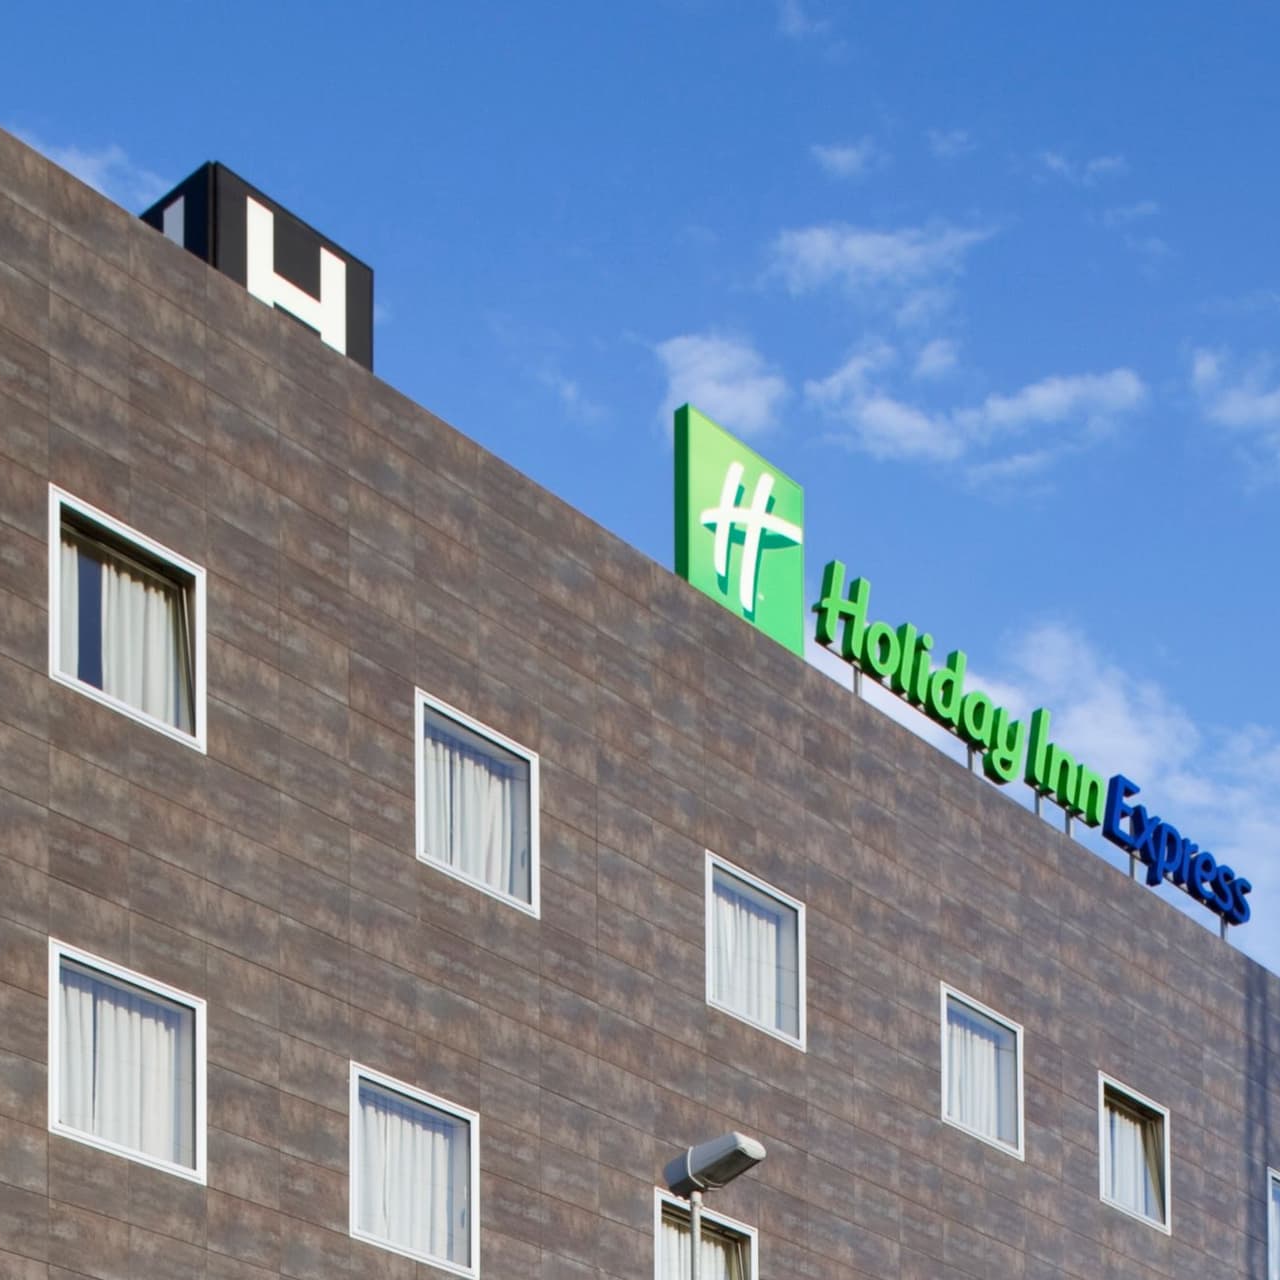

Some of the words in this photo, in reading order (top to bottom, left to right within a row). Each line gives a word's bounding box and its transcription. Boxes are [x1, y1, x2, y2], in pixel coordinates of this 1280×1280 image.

[812, 559, 1026, 785] Holiday
[1024, 706, 1107, 828] Inn
[1102, 773, 1253, 927] Express
